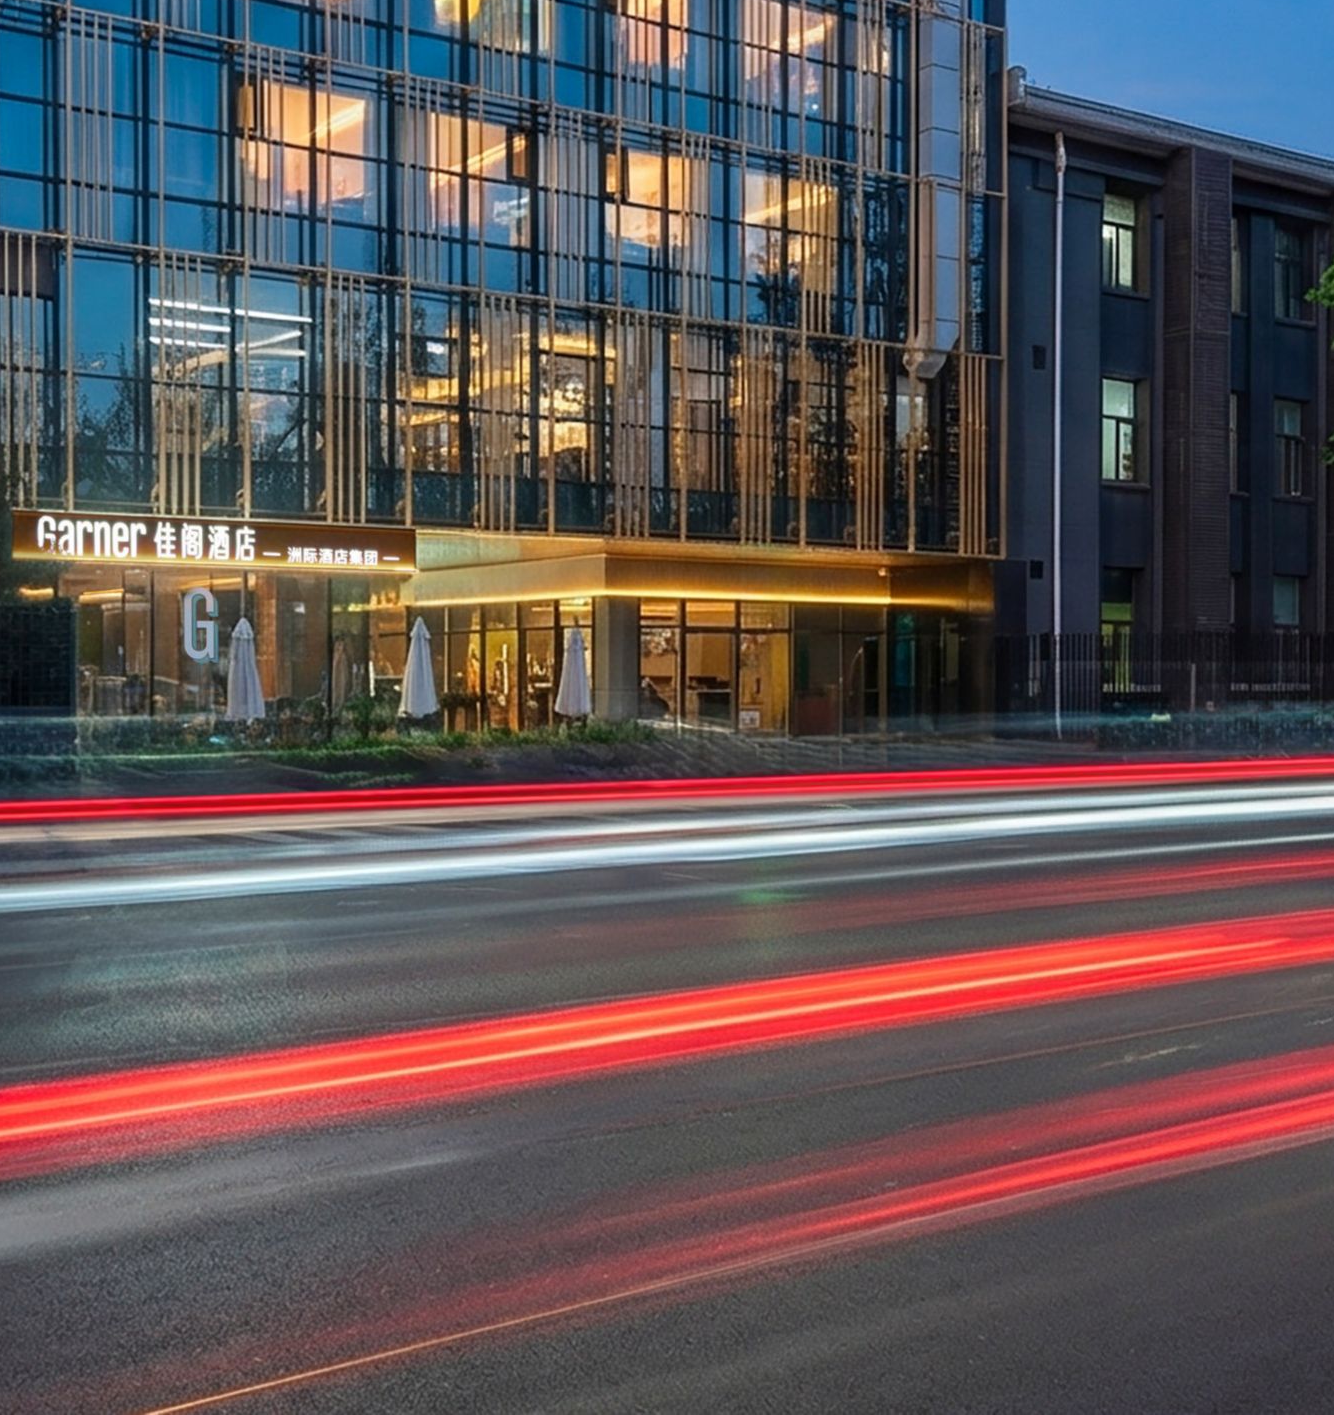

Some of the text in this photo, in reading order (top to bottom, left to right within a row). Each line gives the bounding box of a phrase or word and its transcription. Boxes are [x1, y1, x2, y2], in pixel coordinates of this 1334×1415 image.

[37, 515, 379, 566] Garner 佳阁酒店 洲际酒店集团
[183, 587, 218, 664] G
